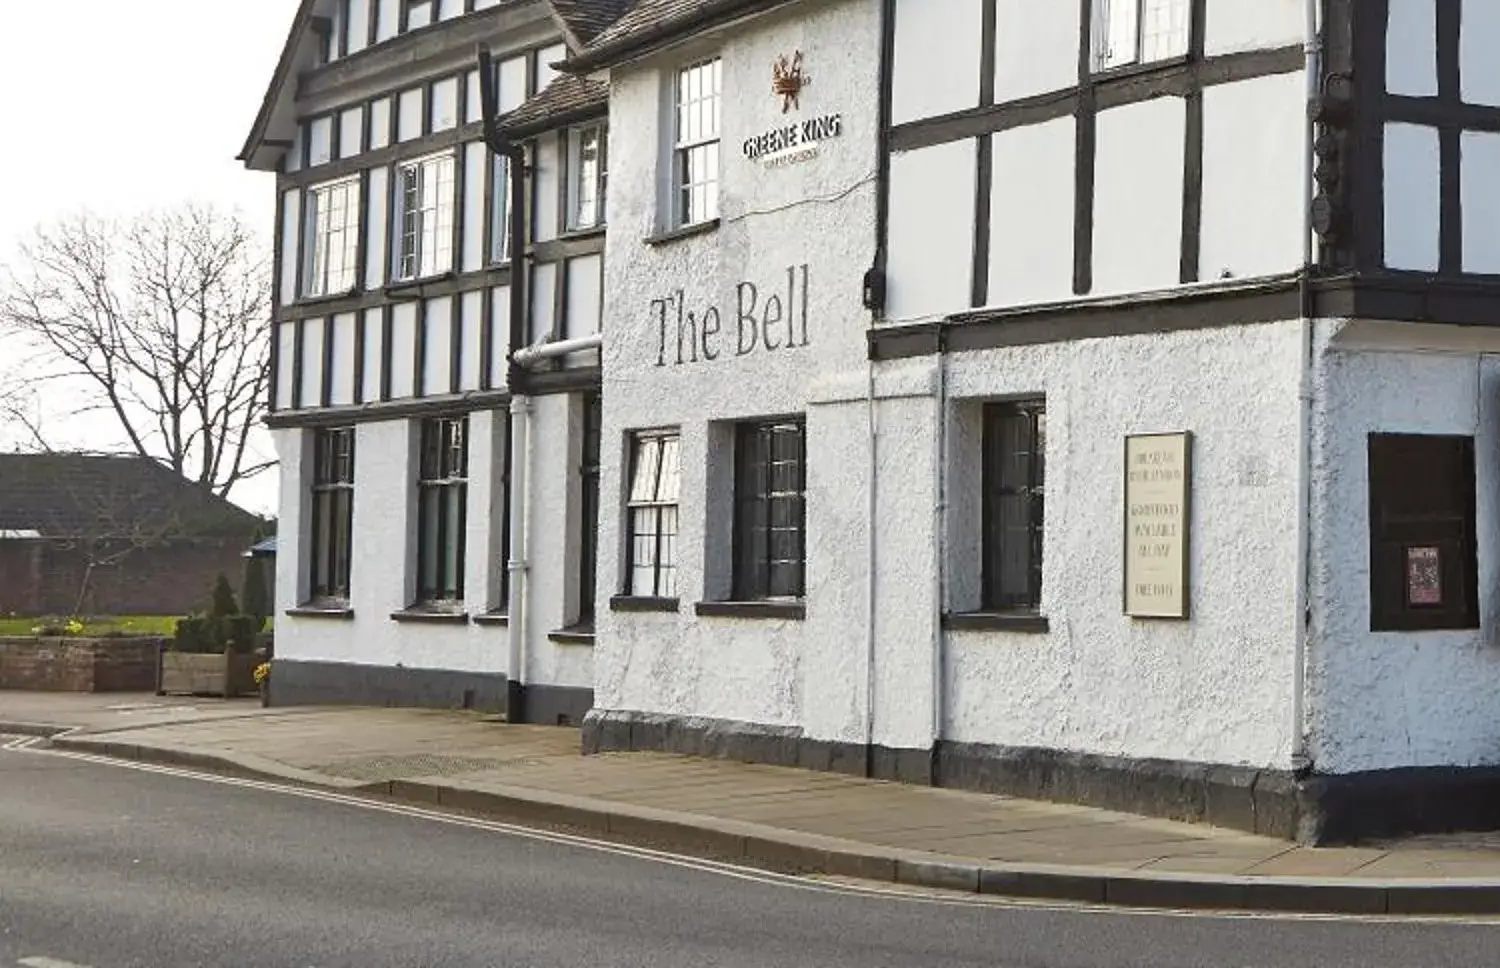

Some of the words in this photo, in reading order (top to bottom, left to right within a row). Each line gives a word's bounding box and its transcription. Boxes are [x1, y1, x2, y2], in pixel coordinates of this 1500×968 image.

[743, 123, 799, 160] GREENE
[801, 113, 842, 144] KING
[650, 288, 721, 367] The
[735, 263, 810, 357] Bell
